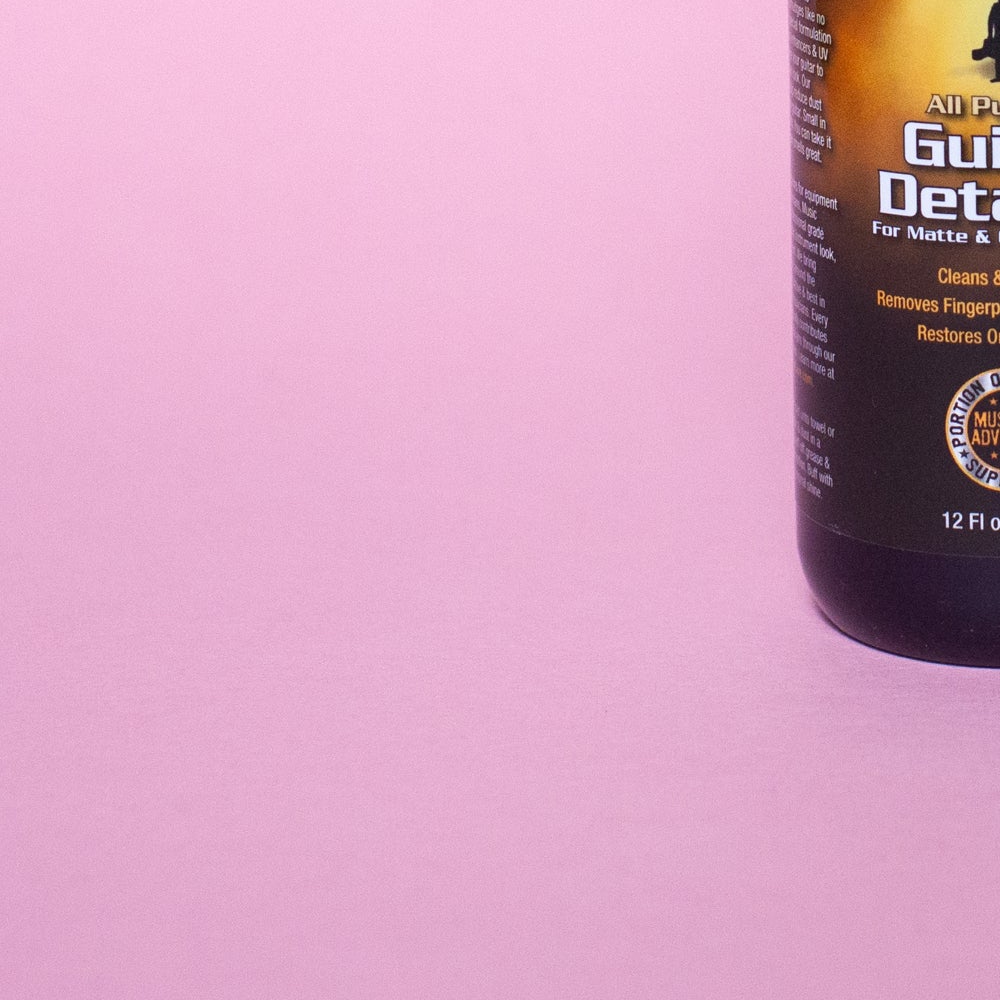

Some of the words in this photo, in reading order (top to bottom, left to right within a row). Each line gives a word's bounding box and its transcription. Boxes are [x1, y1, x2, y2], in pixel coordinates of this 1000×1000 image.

[816, 14, 826, 26] no
[799, 21, 832, 46] formulation
[818, 47, 829, 61] UV
[816, 63, 824, 78] to
[925, 93, 962, 116] All
[819, 116, 827, 130] in
[811, 130, 825, 147] take
[826, 135, 832, 150] it
[804, 188, 838, 211] equipment
[807, 223, 825, 240] grade
[872, 220, 901, 238] For
[907, 225, 968, 244] Matte
[975, 229, 991, 245] &
[819, 243, 837, 263] look,
[937, 266, 989, 286] Cleans
[877, 289, 939, 314] Removes
[811, 307, 829, 329] Every
[917, 323, 983, 345] Restores
[823, 350, 836, 363] our
[827, 367, 835, 380] at
[949, 379, 986, 449] PORTION
[827, 426, 836, 439] or
[818, 472, 834, 488] with
[941, 511, 963, 530] 12
[969, 512, 985, 531] Fl
